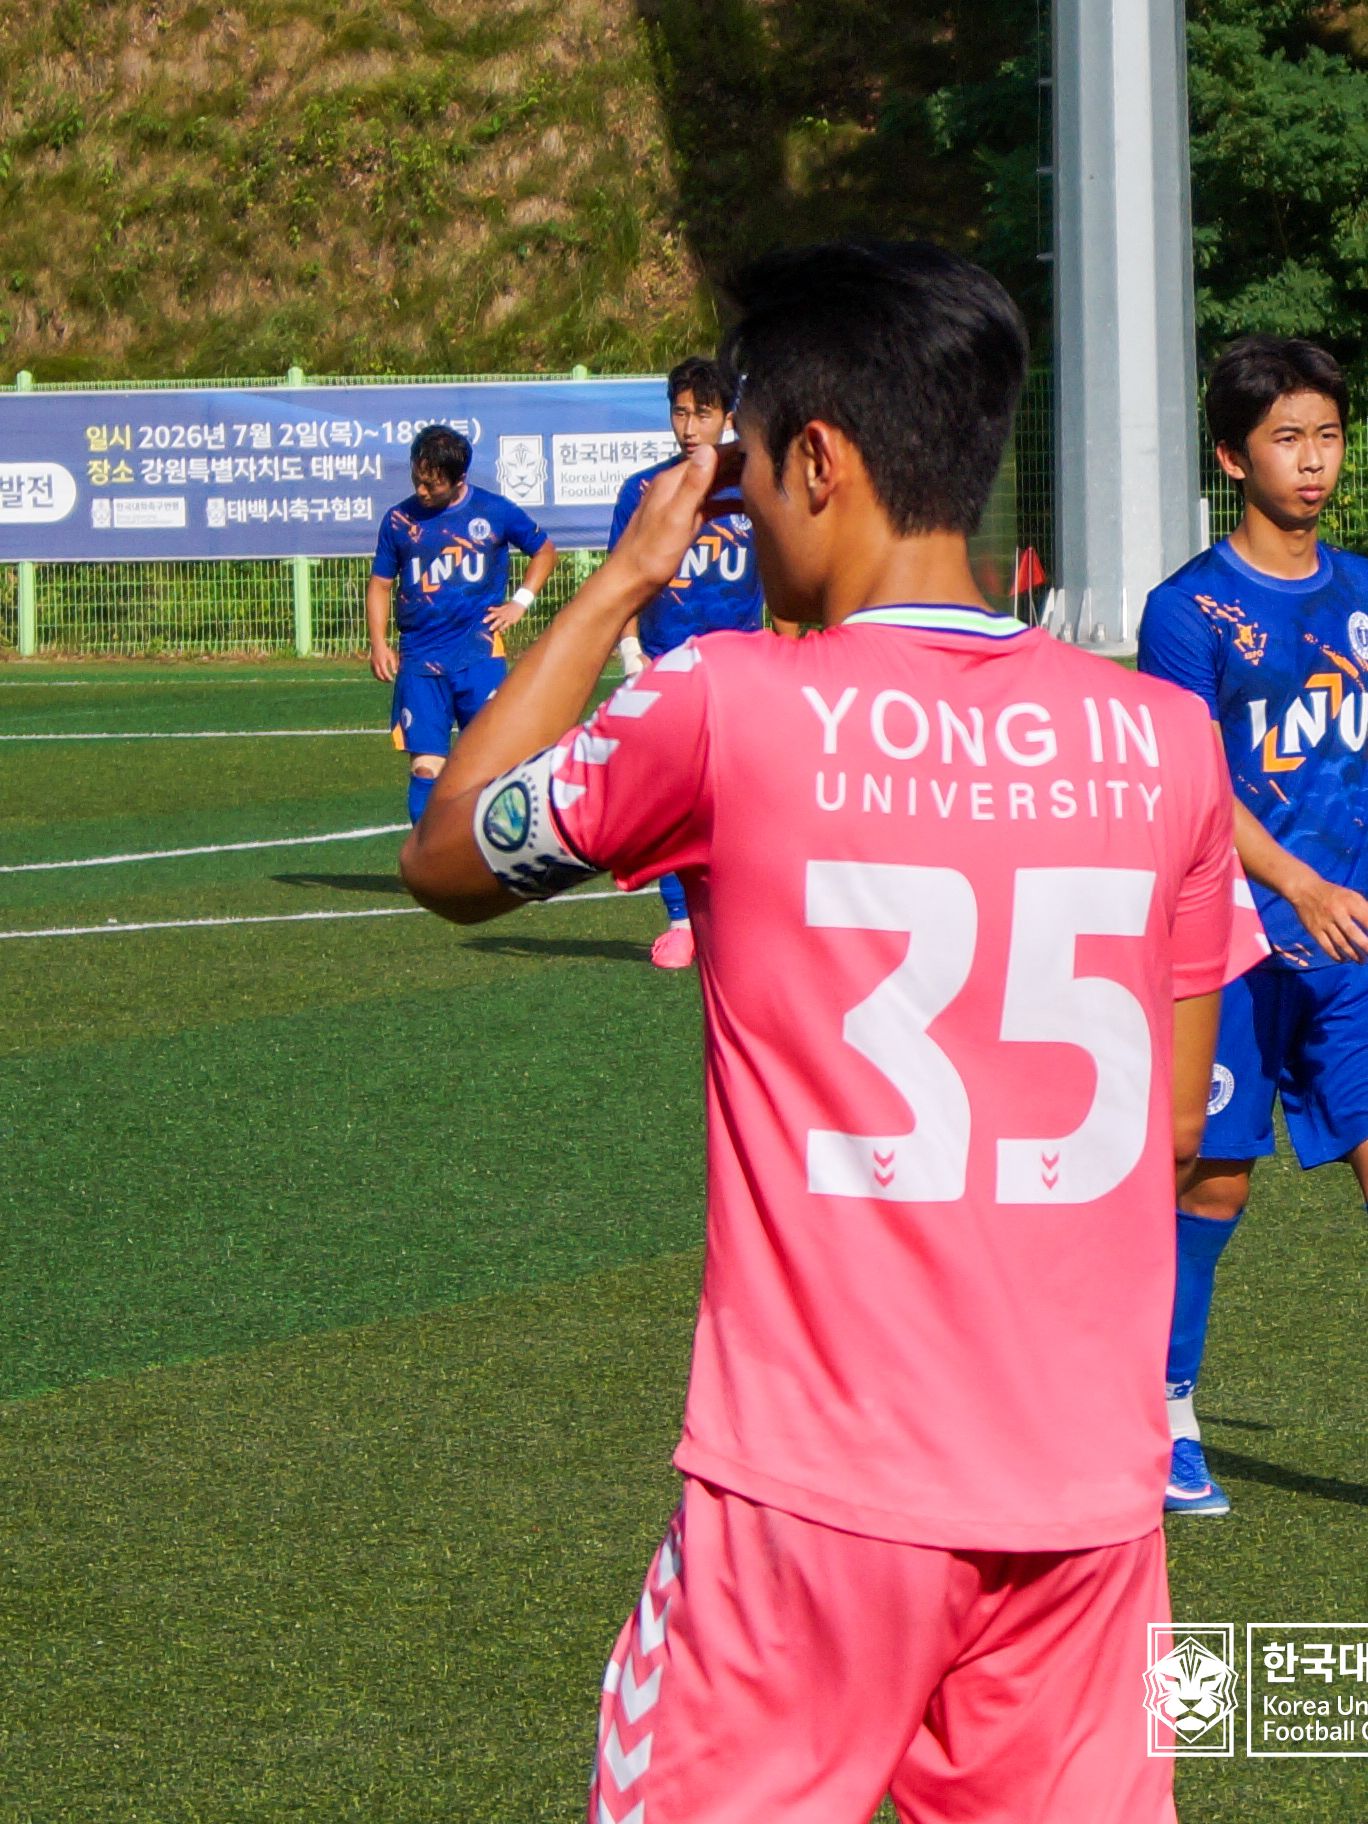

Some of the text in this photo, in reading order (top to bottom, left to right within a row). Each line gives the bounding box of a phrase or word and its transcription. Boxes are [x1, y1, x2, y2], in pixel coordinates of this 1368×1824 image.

[86, 424, 131, 451] 일시
[138, 423, 226, 449] 2026년
[232, 422, 271, 448] 7월
[559, 440, 681, 466] 한국대학축구
[87, 454, 382, 485] 장소 강원특별자치도 태백시
[561, 470, 629, 483] Korea Univ
[0, 474, 54, 508] 발전
[561, 483, 610, 497] Football
[227, 496, 373, 523] 태백시축구협회
[411, 552, 484, 584] INU
[679, 545, 747, 581] NU
[802, 686, 1160, 768] YONG IN
[815, 771, 1162, 822] UNIVERSITY
[806, 859, 1156, 1204] 35
